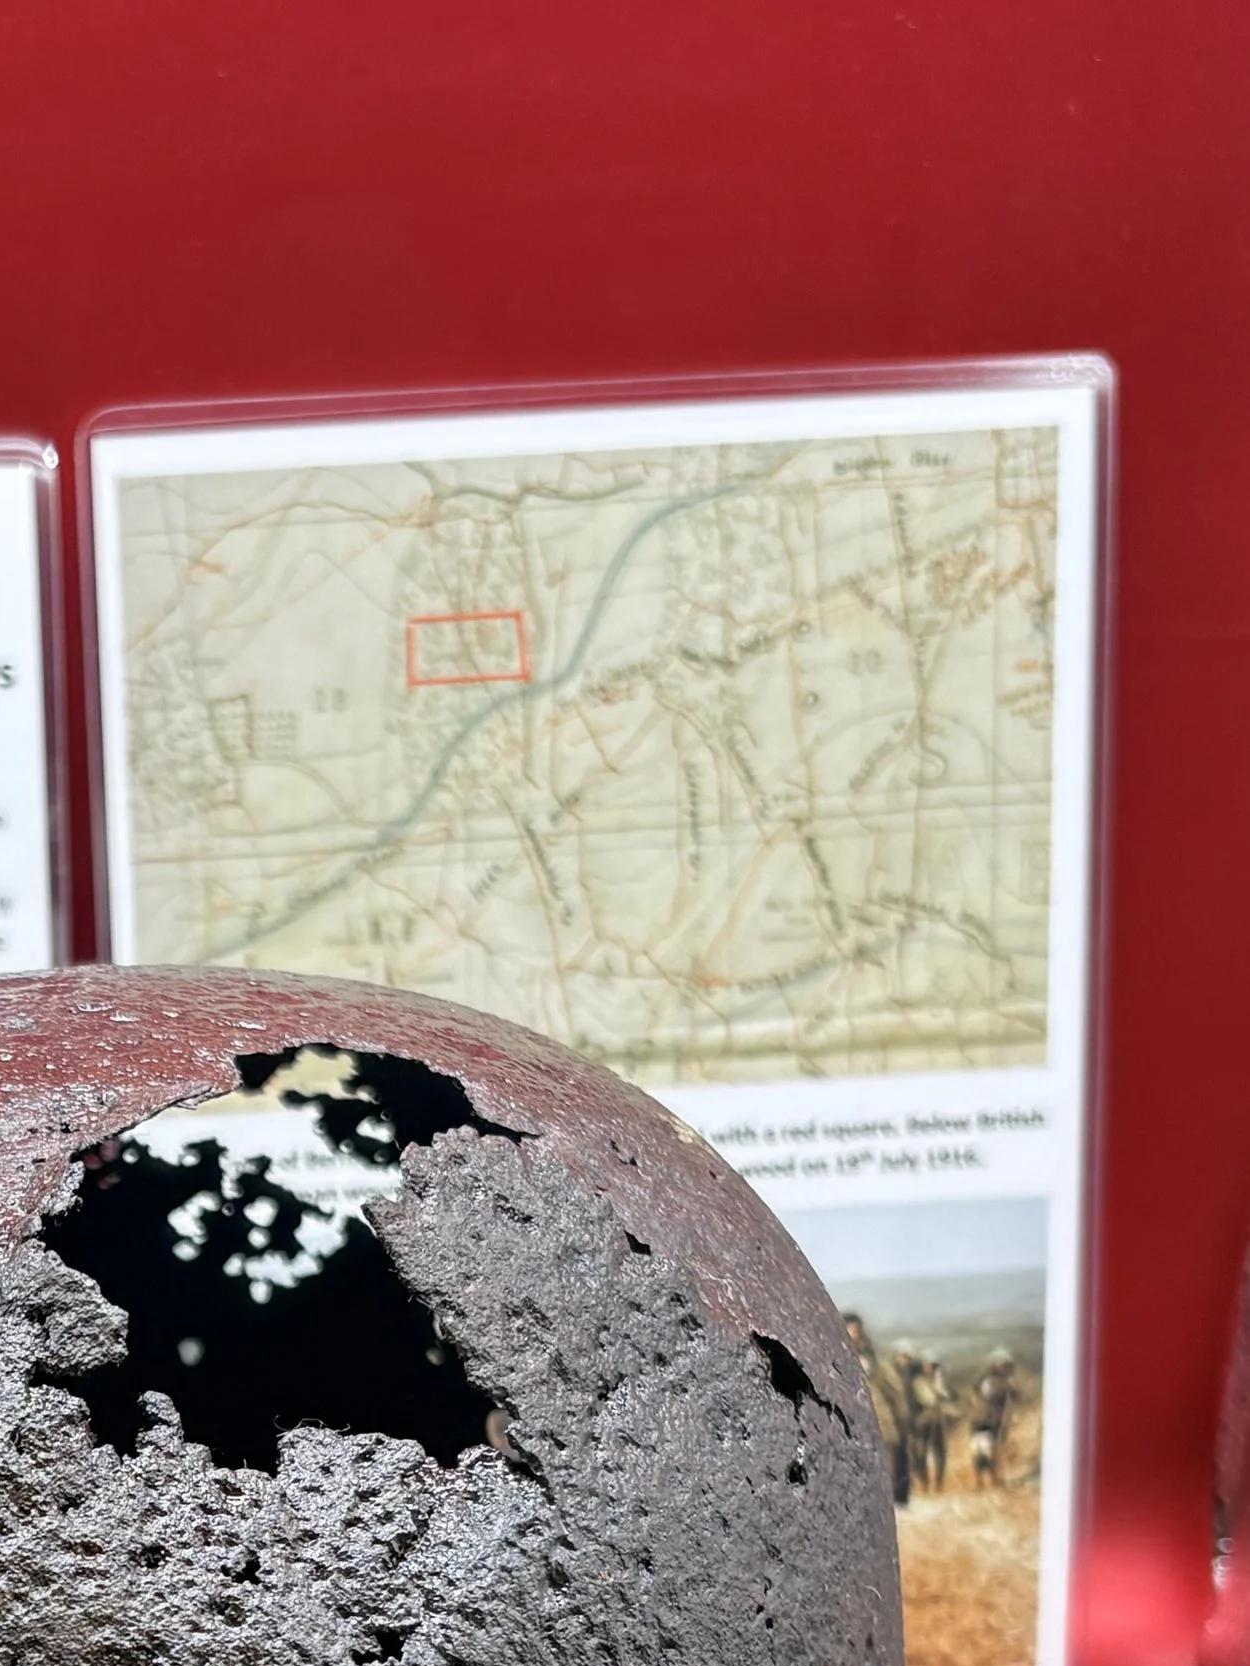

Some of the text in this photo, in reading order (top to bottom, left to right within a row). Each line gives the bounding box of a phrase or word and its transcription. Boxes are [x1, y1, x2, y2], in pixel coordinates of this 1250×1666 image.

[711, 1125, 758, 1145] with
[762, 1127, 776, 1144] a
[780, 1120, 818, 1142] red
[800, 1159, 829, 1177] on
[879, 1151, 921, 1172] July
